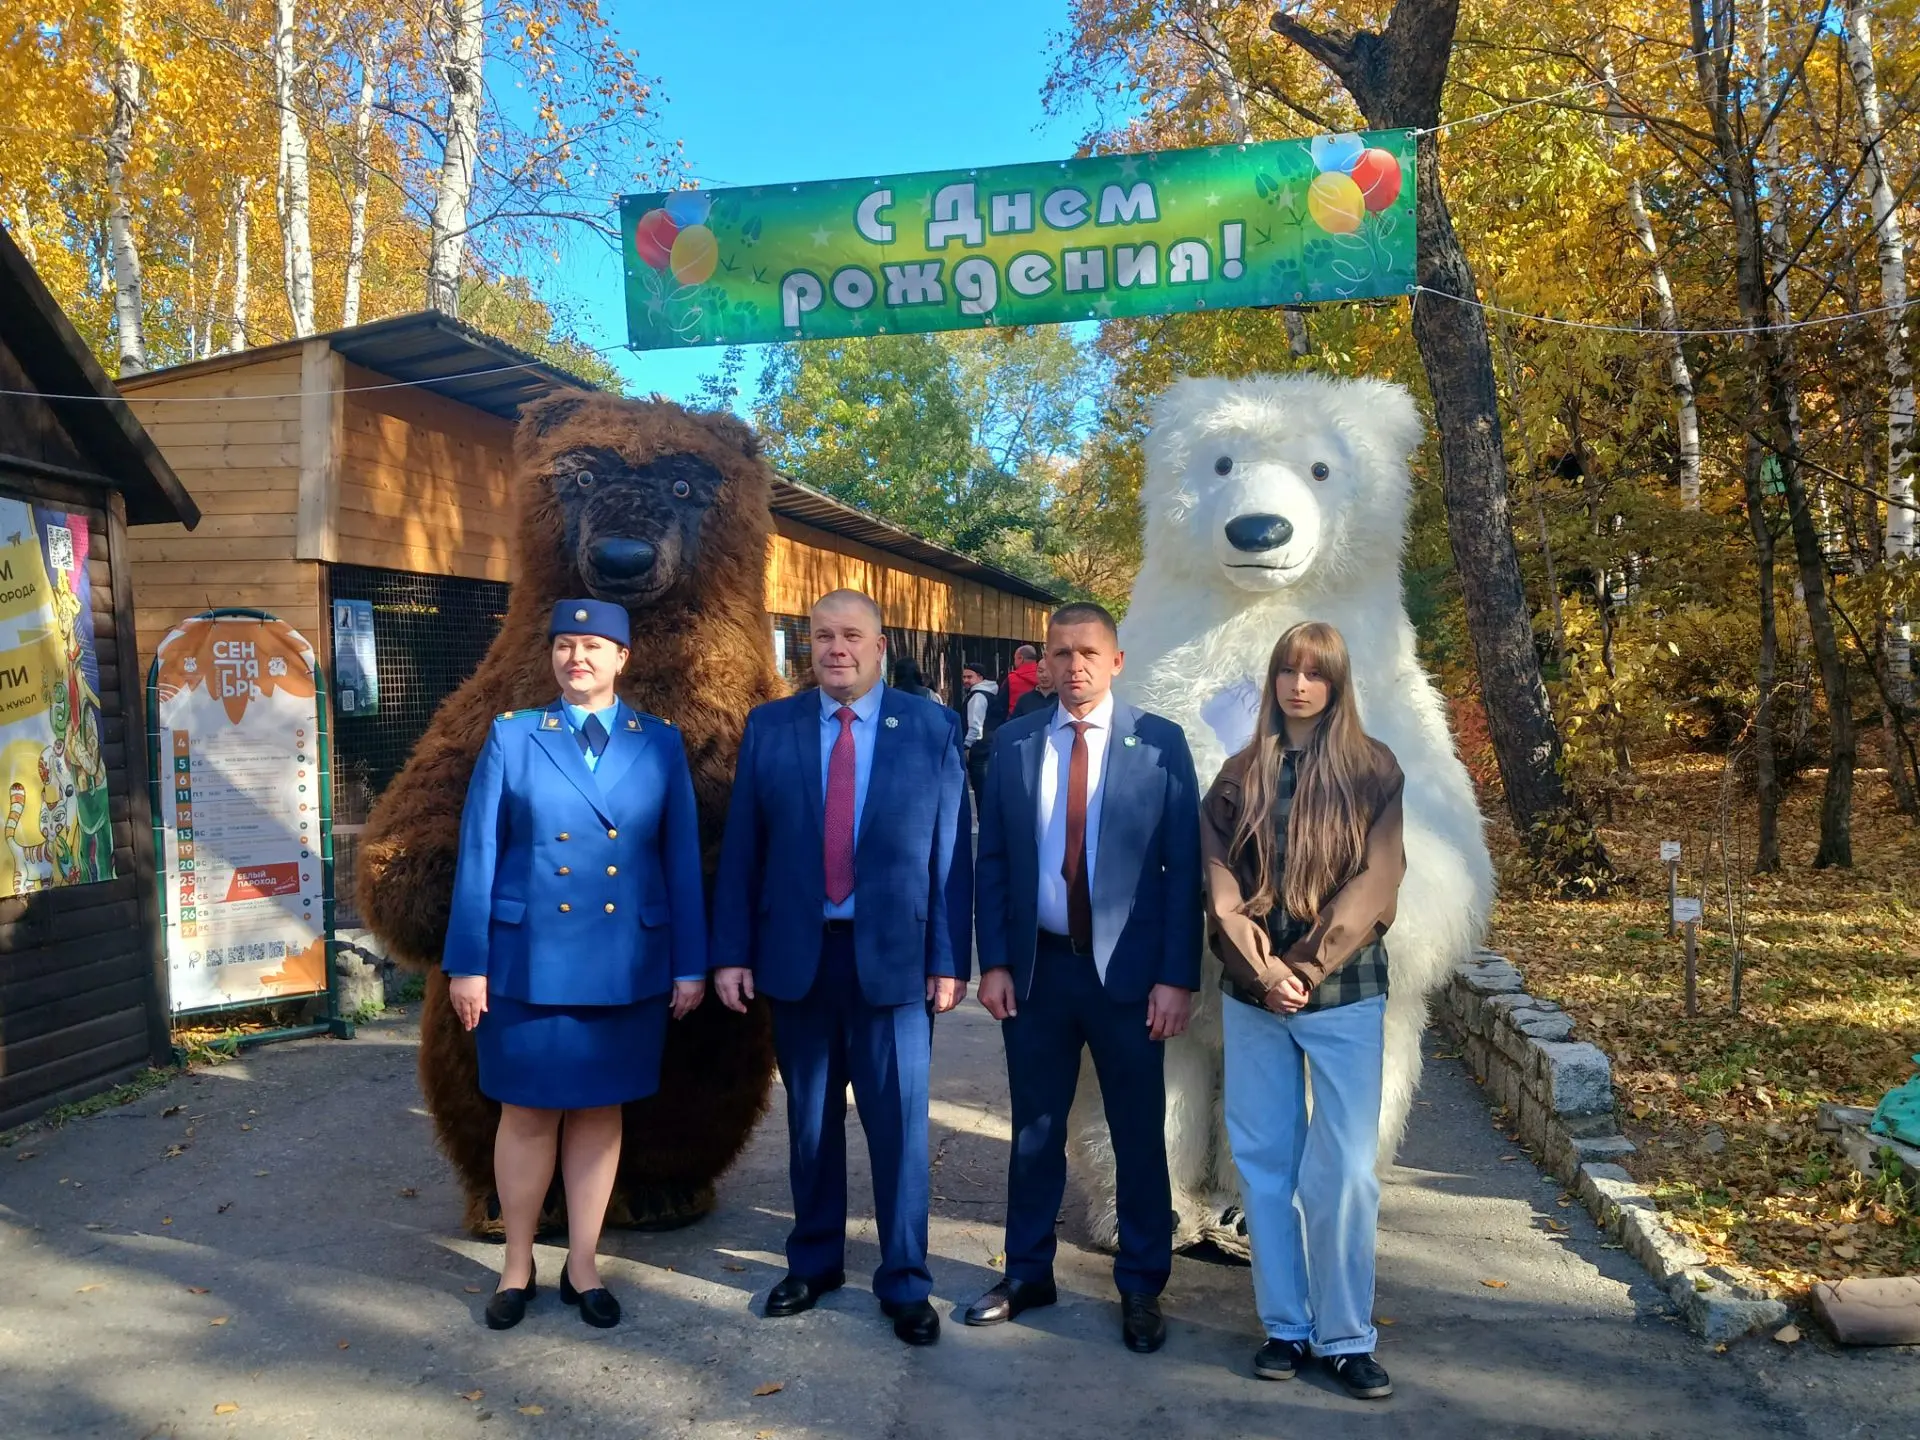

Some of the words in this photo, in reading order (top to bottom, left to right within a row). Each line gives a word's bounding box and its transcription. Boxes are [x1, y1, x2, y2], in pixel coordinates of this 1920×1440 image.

[927, 181, 1159, 249] Днем
[781, 222, 1246, 328] рождения!
[212, 640, 255, 658] СЕН
[213, 659, 259, 678] ТЯ
[222, 669, 262, 697] БРЬ
[177, 737, 187, 748] 4
[178, 759, 187, 770] 5
[179, 775, 187, 785] 6
[178, 790, 190, 801] 11
[177, 811, 191, 821] 12
[178, 829, 192, 840] 13
[179, 844, 192, 855] 19
[179, 860, 194, 870] 20
[237, 869, 267, 881] БЕЛЫЙ
[180, 875, 195, 887] 25
[237, 877, 277, 889] ПАРОХОД
[180, 892, 195, 903] 26
[181, 910, 196, 921] 26
